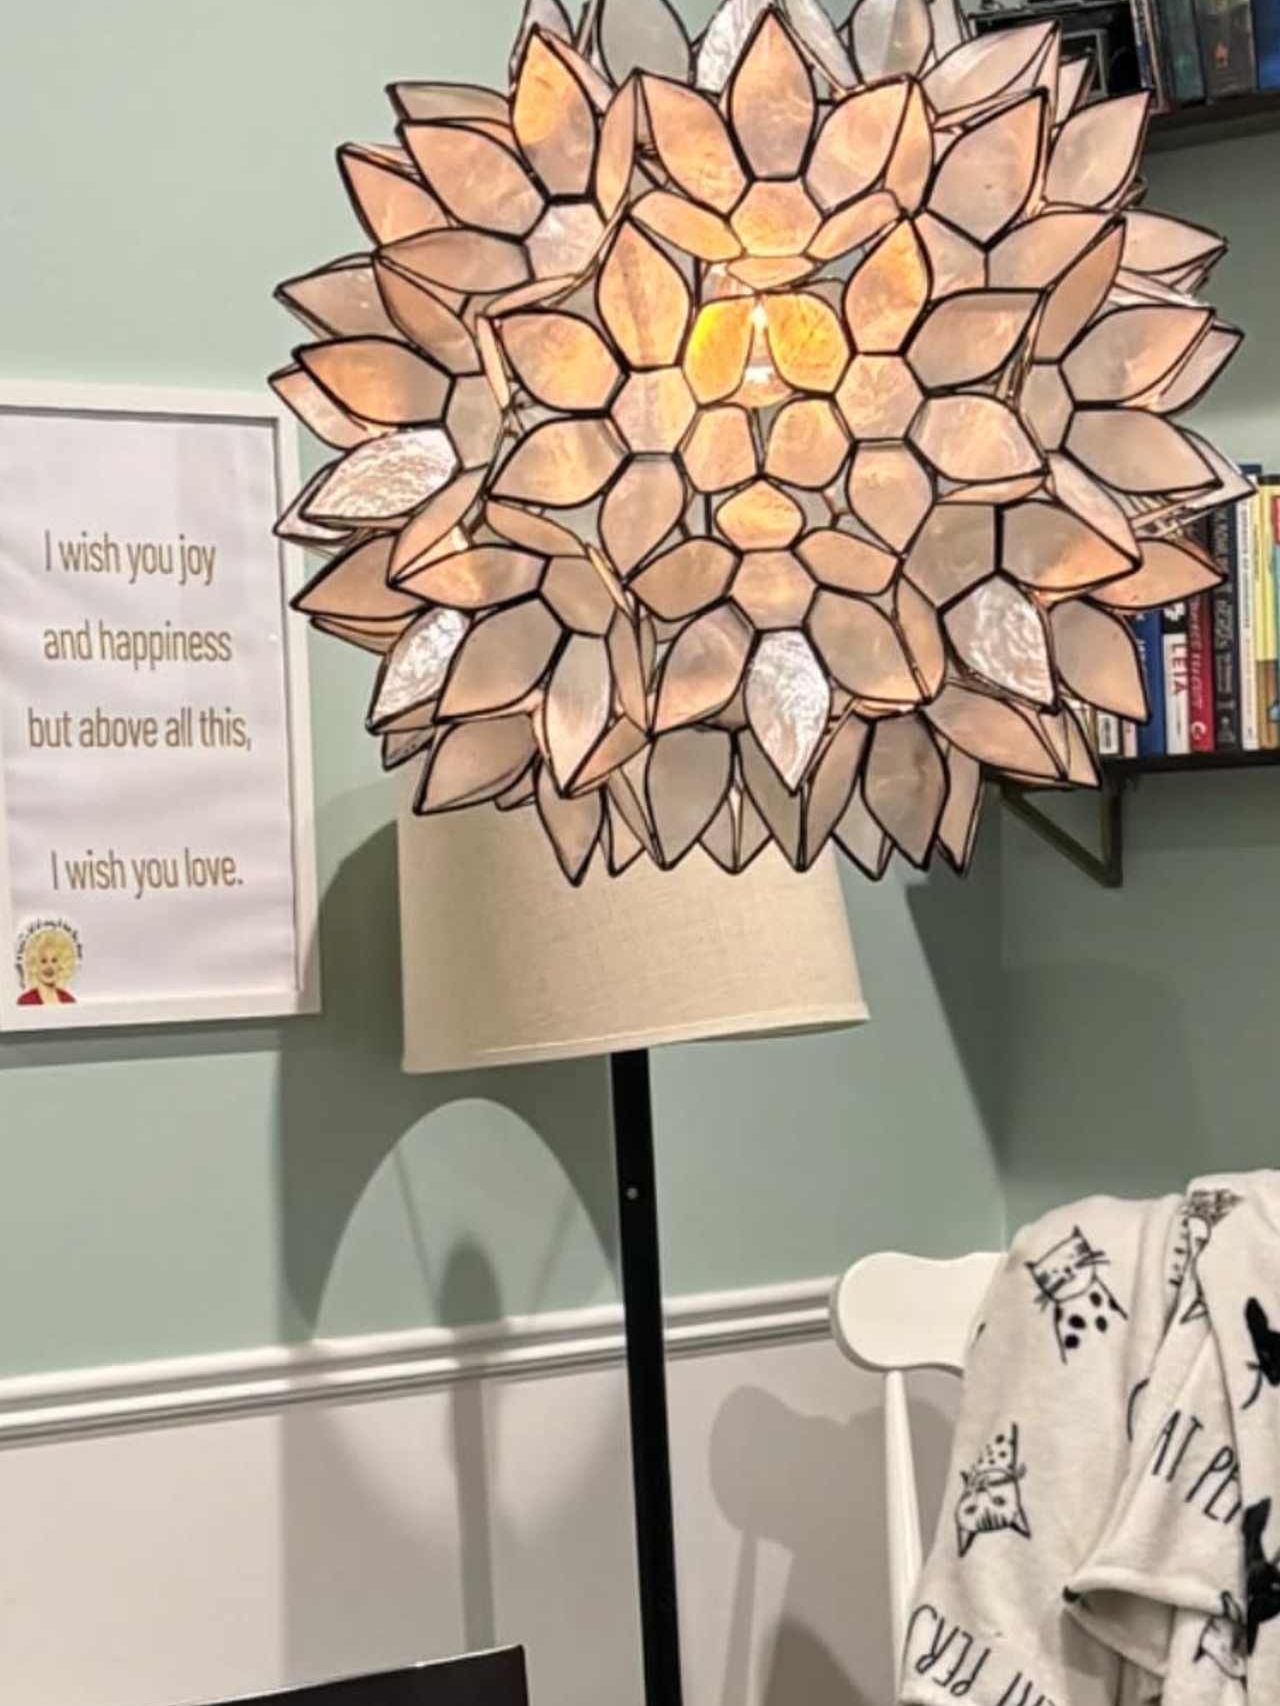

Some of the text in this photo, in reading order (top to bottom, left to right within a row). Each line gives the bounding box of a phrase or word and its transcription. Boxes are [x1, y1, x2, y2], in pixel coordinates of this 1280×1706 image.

[44, 529, 217, 586] I wish you joy
[43, 619, 233, 671] and happiness
[27, 706, 252, 752] but above all this,
[51, 847, 244, 900] I wish you love.
